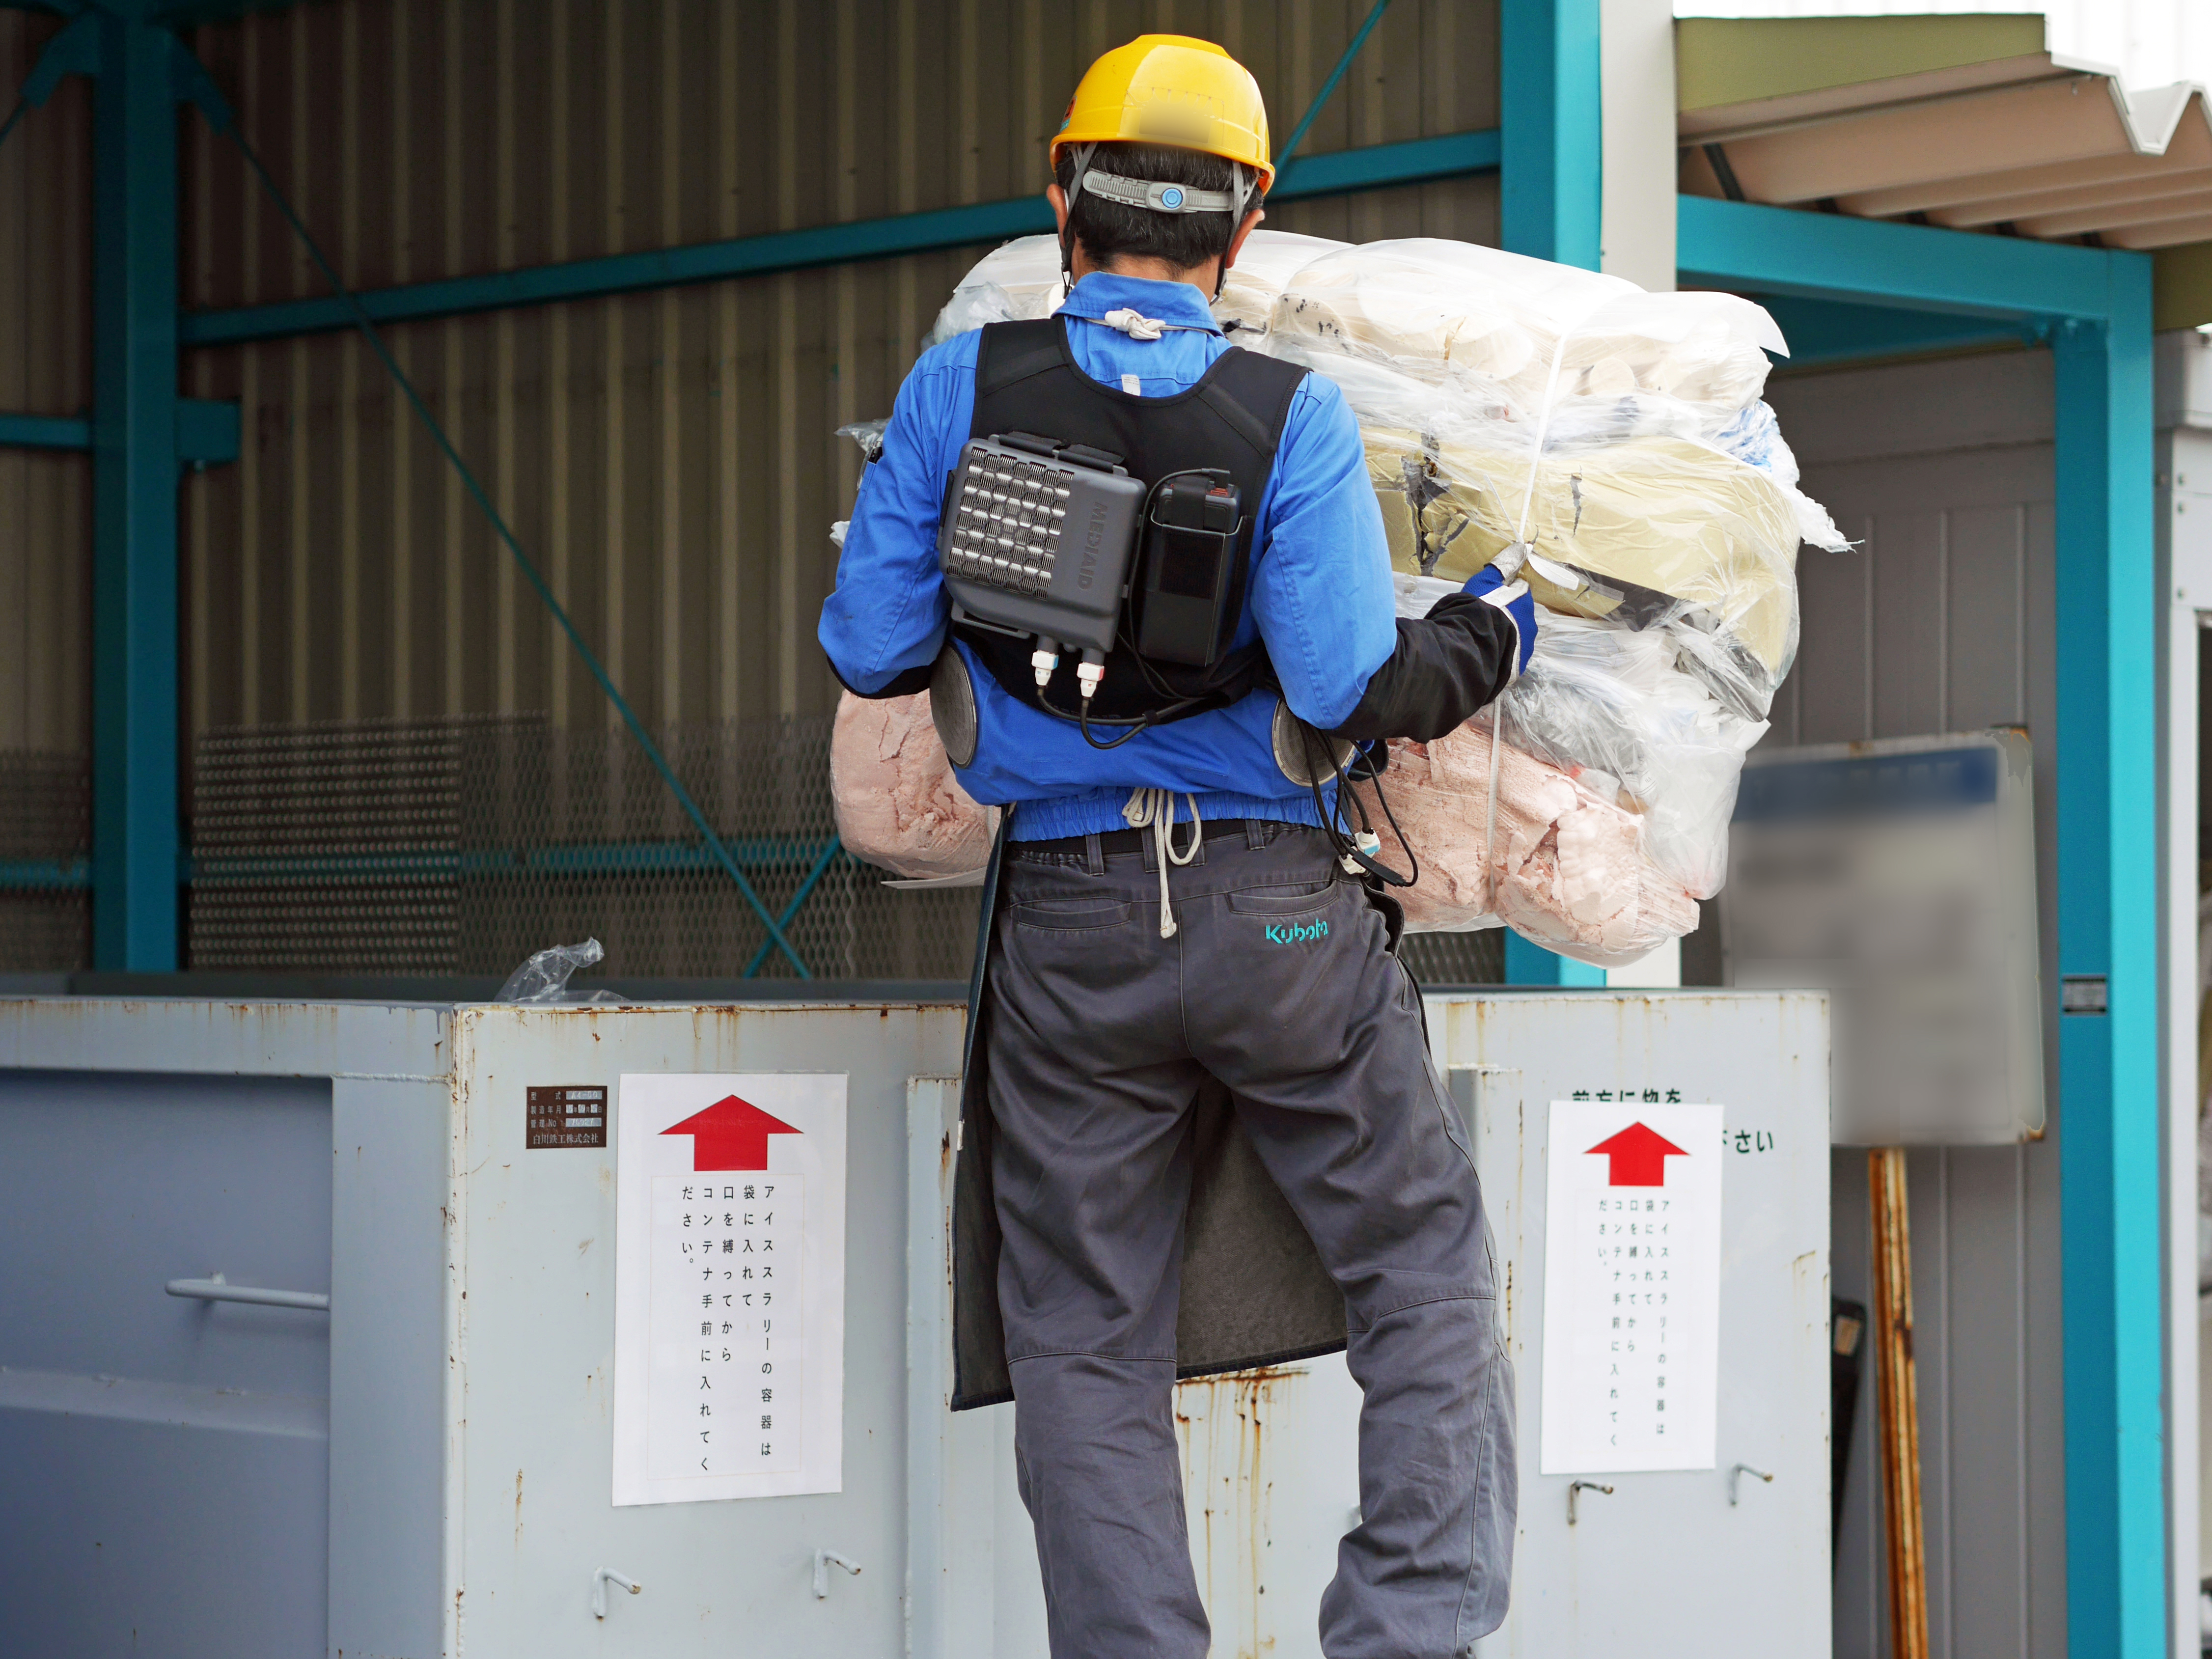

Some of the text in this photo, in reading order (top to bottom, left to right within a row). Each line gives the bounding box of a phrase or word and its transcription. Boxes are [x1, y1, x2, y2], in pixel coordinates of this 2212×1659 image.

[1077, 501, 1108, 590] MEDIAID
[1266, 918, 1328, 944] Kubota
[533, 1133, 599, 1145] 白川鉄工株式会社
[682, 1186, 693, 1263] ださい。
[721, 1187, 734, 1362] 口を縛ってから
[742, 1185, 755, 1306] 袋に入れて
[700, 1188, 713, 1471] コンテナ手前に入れてく
[761, 1186, 774, 1456] アイススラリーの容器は
[1610, 1201, 1622, 1447] コンテナ手前に入れてく
[1657, 1200, 1669, 1435] アイススラリーの容器は
